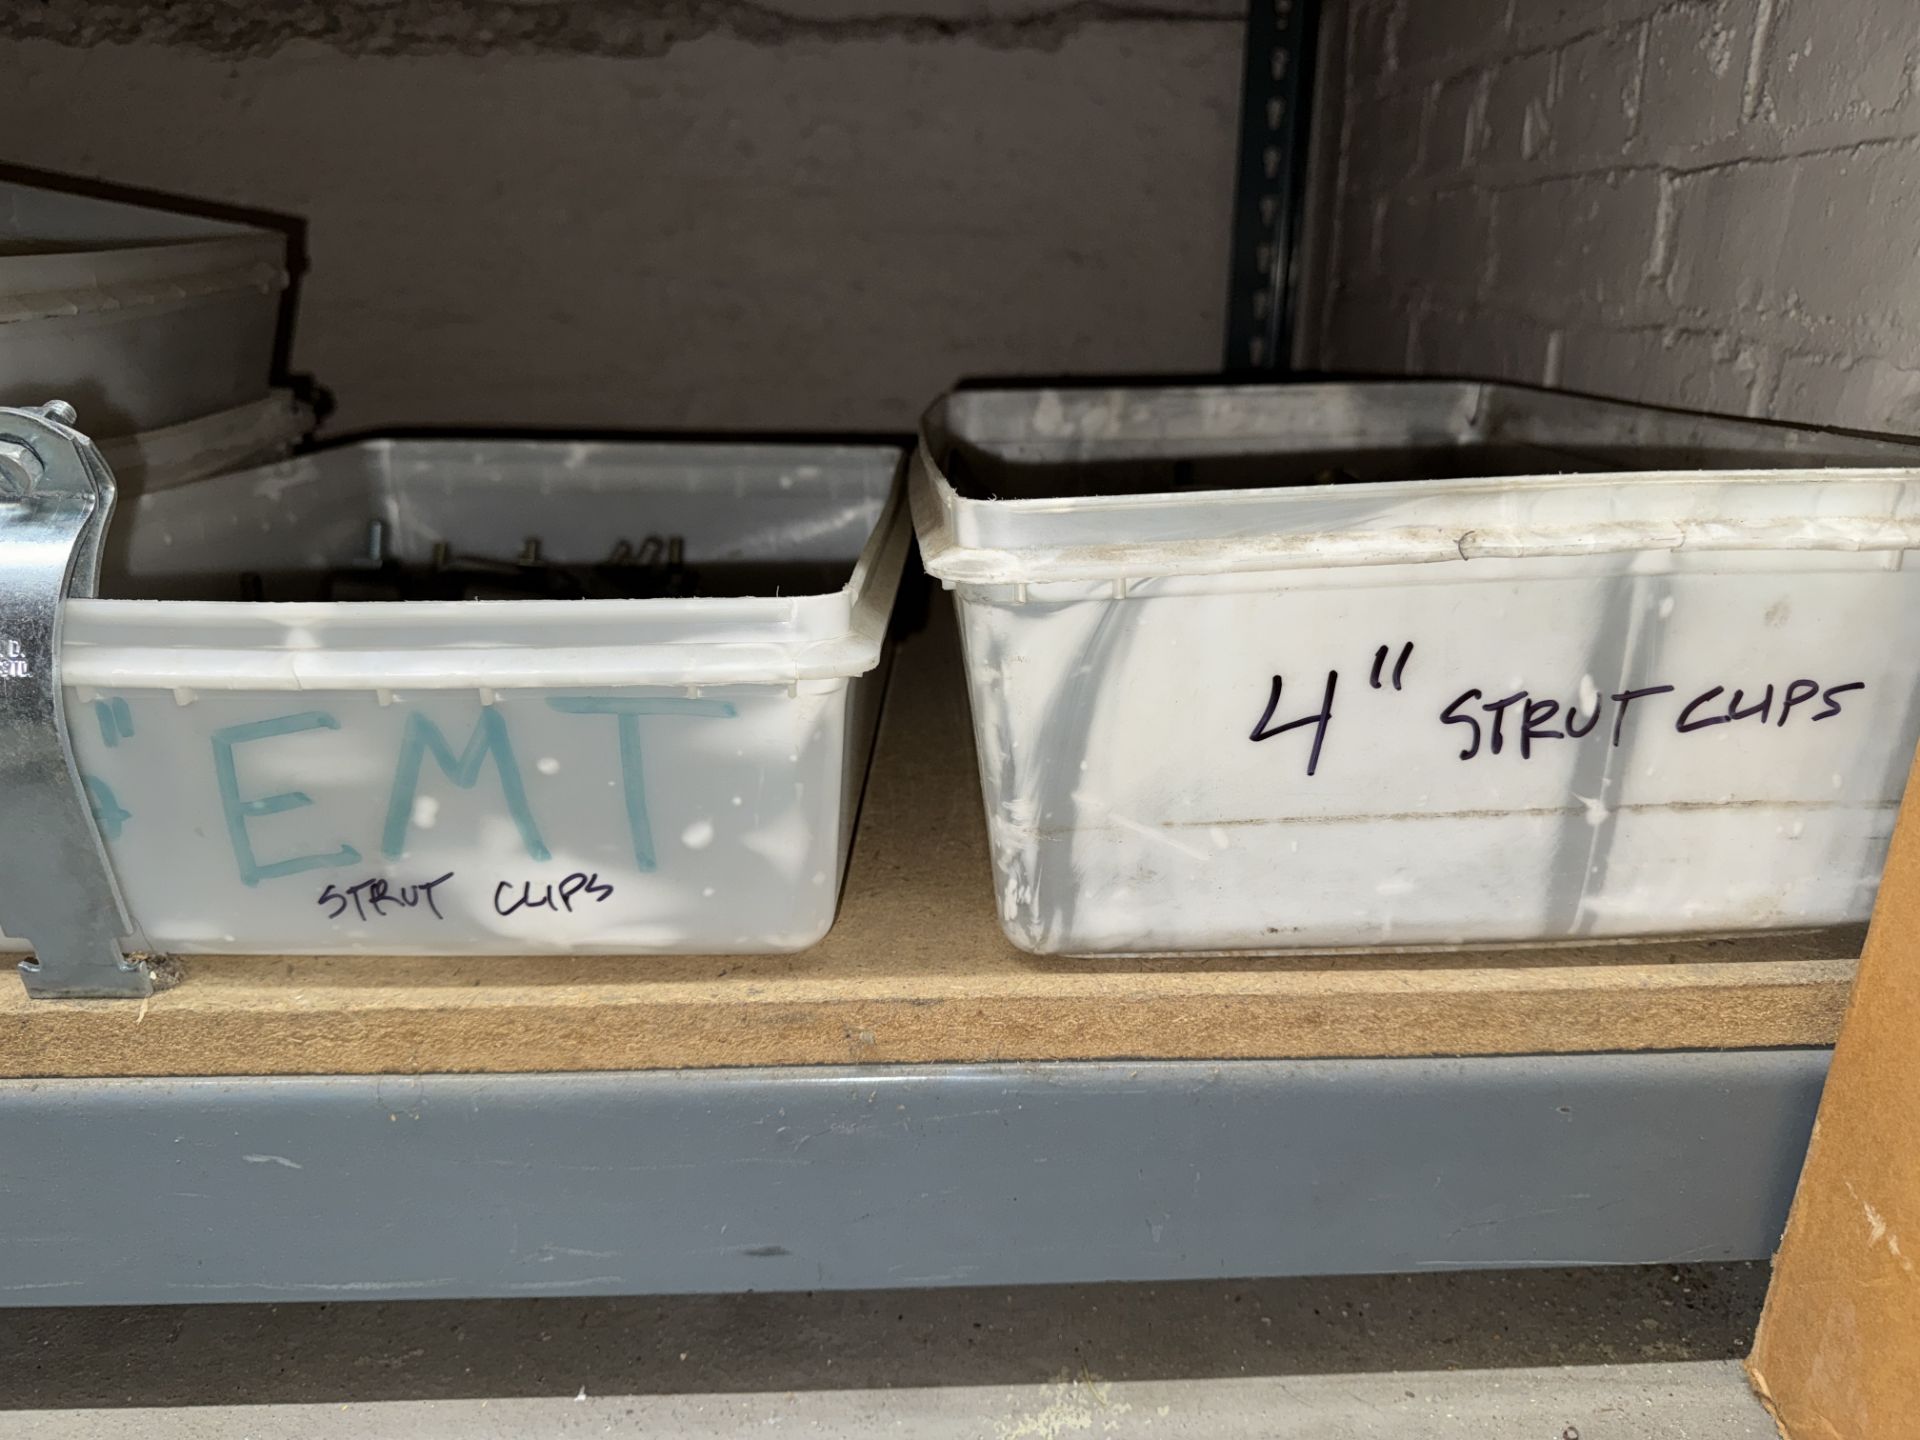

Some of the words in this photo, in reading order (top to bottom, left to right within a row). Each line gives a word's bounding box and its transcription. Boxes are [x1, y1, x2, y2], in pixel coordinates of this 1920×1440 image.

[1249, 641, 1414, 777] 4"
[1439, 685, 1675, 761] STRUT
[1676, 680, 1866, 733] CLIPS
[212, 696, 738, 887] EMT
[317, 872, 454, 921] STRUT
[494, 872, 614, 916] CLIPS
